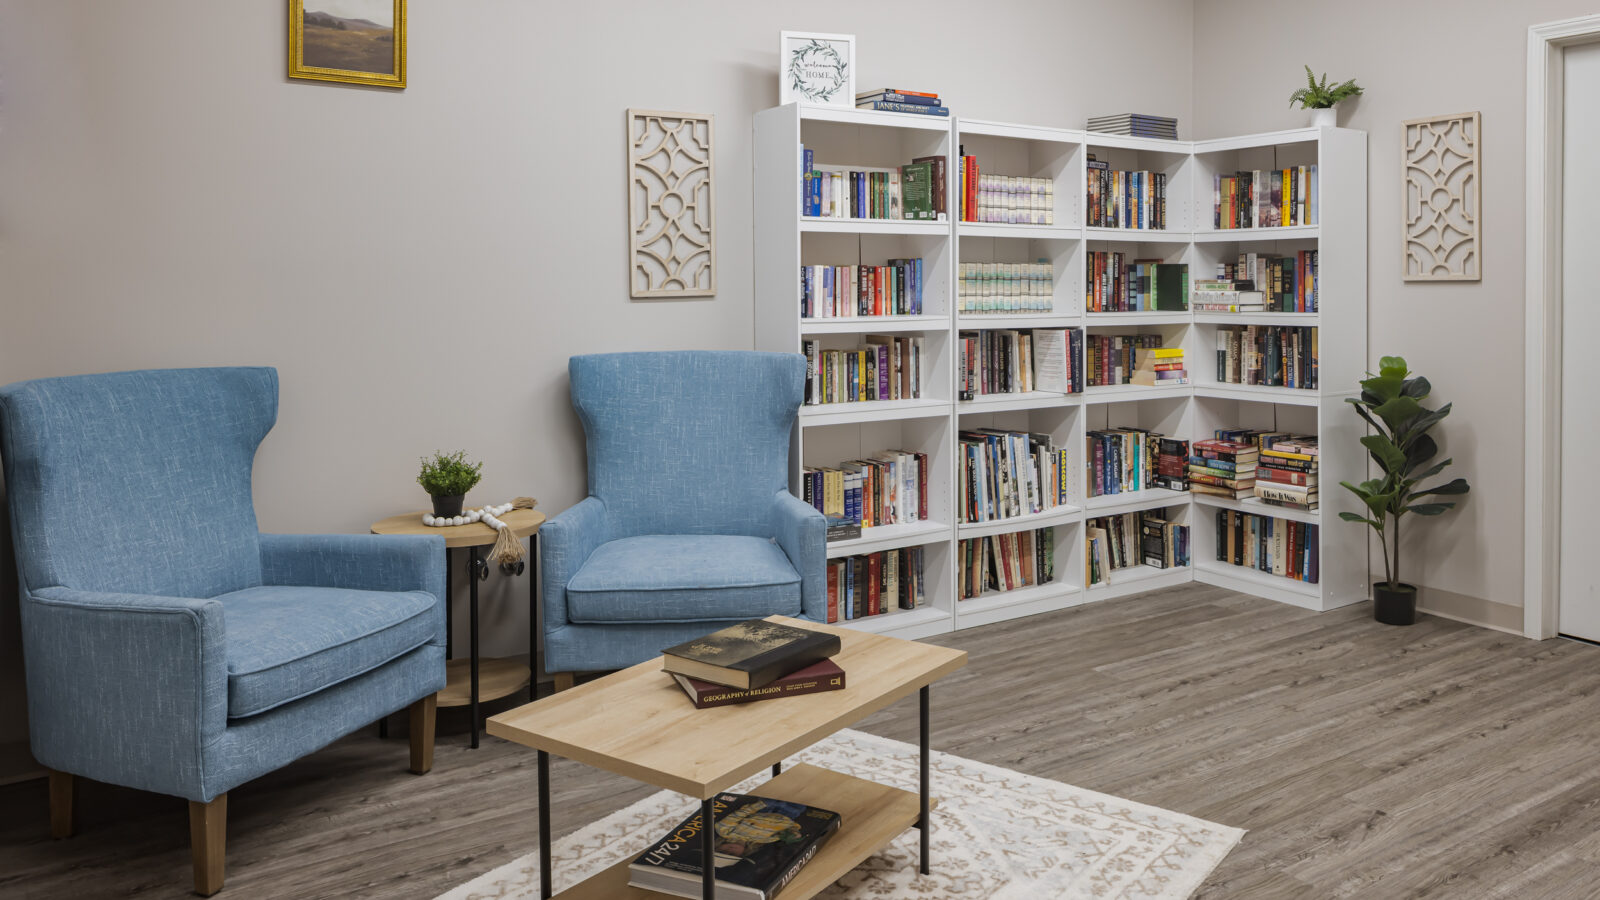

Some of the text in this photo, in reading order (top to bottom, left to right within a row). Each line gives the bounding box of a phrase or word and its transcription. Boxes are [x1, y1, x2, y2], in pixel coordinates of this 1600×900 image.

[877, 102, 900, 111] JANE'S
[1263, 490, 1277, 498] How
[1284, 493, 1297, 502] Was
[703, 692, 744, 702] GEOGRAPHY
[750, 686, 781, 696] RELIGION
[781, 857, 806, 889] AMERICA
